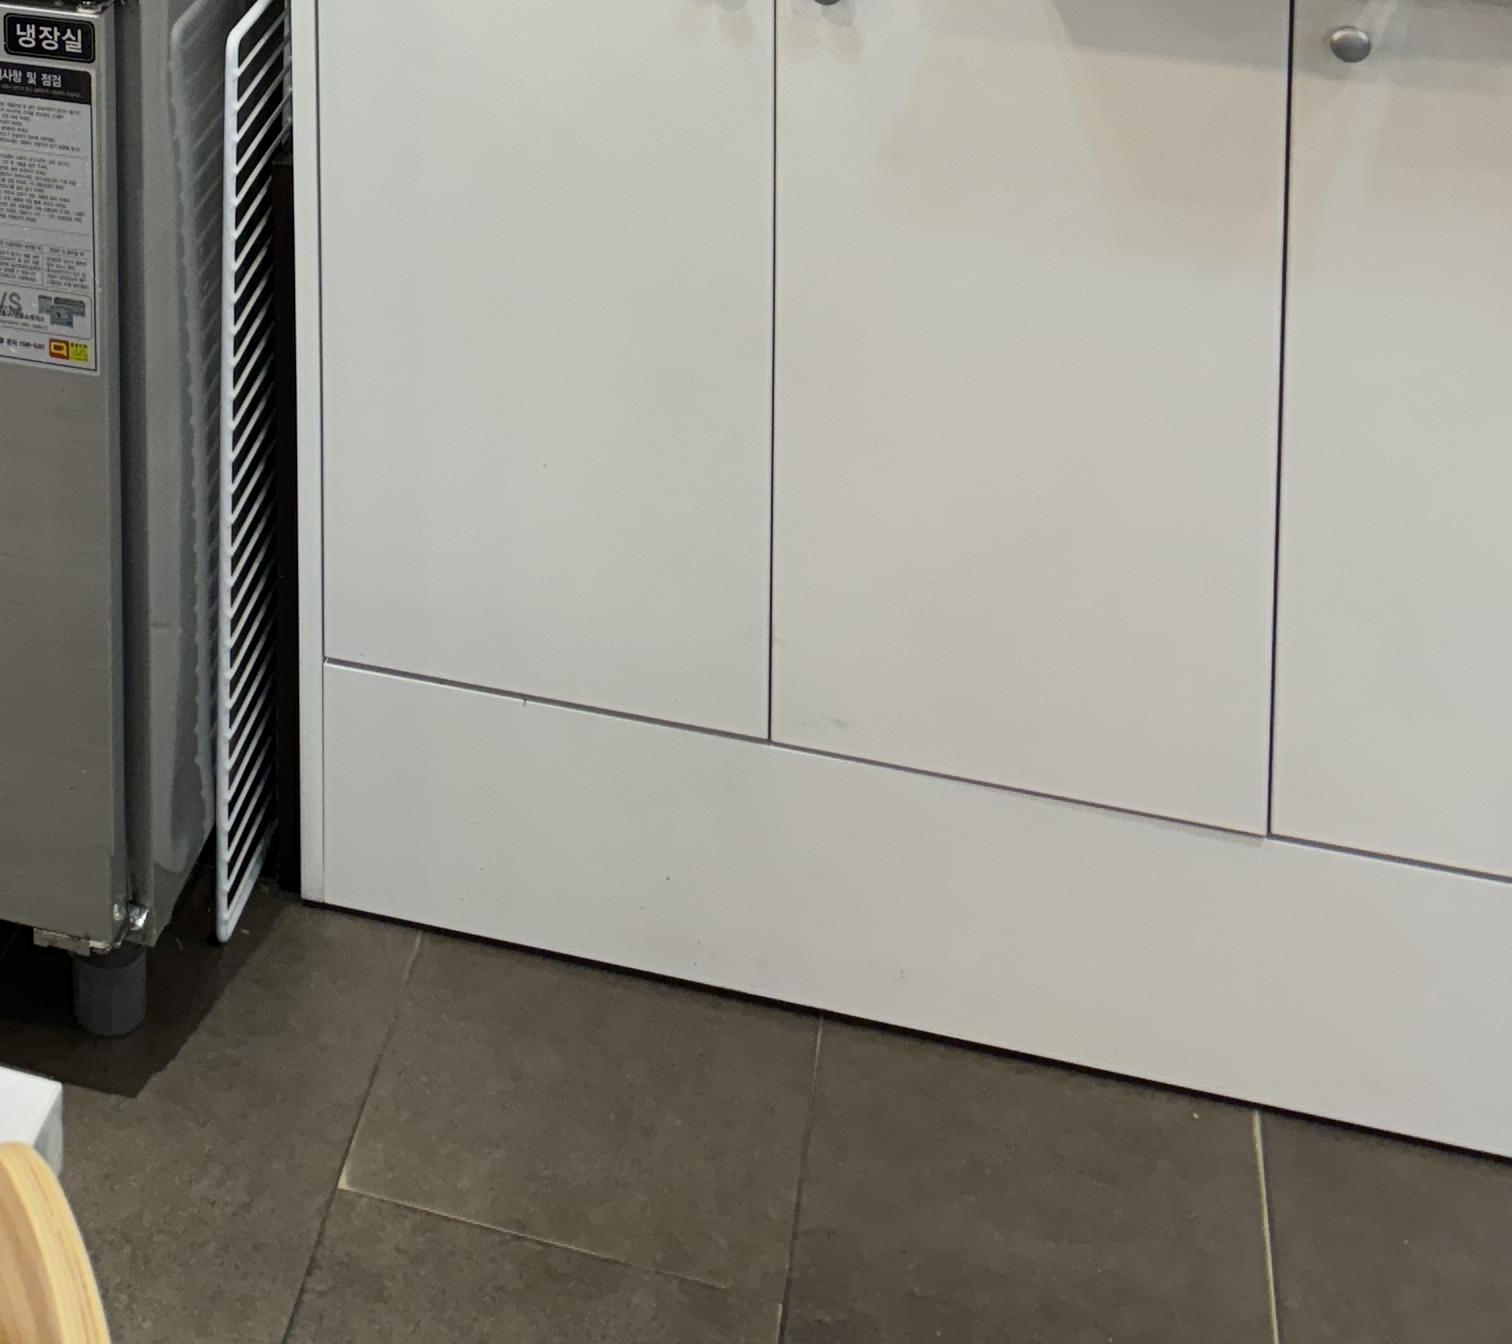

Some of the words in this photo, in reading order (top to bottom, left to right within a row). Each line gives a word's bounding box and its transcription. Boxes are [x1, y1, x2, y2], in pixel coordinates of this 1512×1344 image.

[15, 22, 84, 54] 냉장실
[26, 71, 37, 85] 및
[40, 73, 62, 88] 점검
